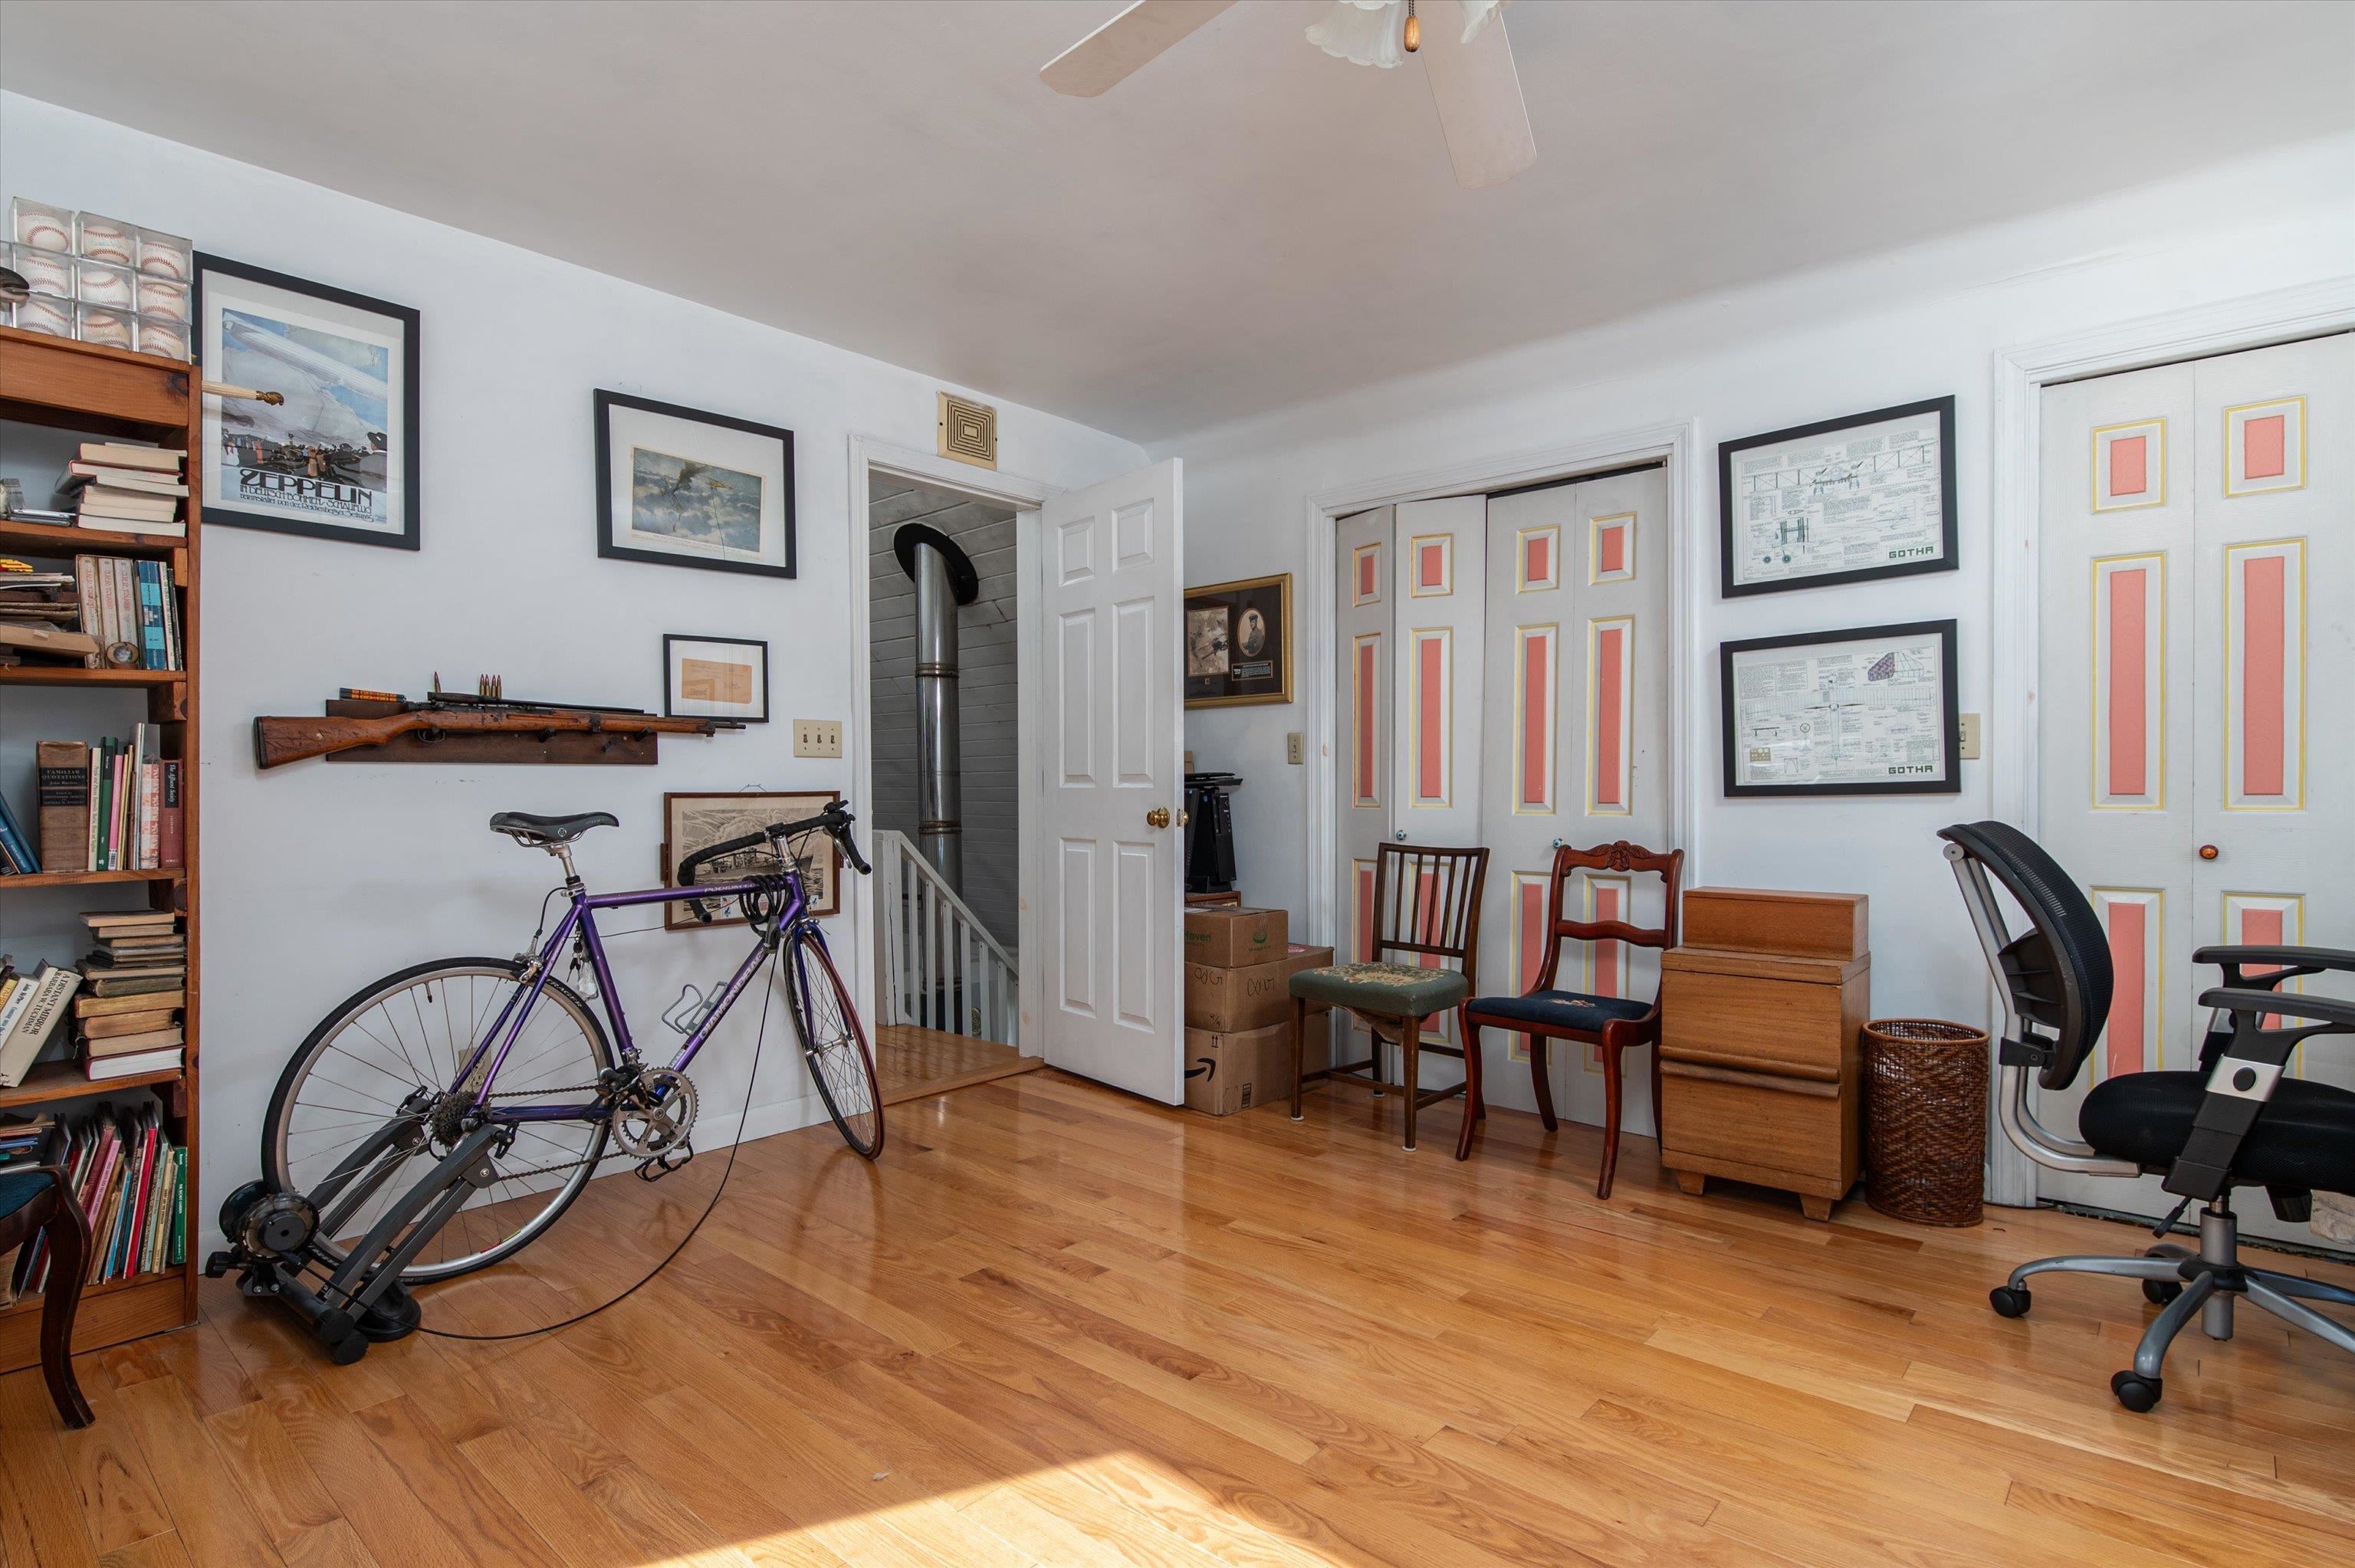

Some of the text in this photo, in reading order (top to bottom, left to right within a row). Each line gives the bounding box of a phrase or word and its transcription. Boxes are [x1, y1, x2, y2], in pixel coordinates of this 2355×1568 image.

[239, 468, 372, 507] ZEPPELIN
[1888, 546, 1933, 559] GOTHA
[1888, 765, 1933, 774] GOTHA
[42, 972, 61, 996] BARBARA
[47, 979, 68, 1007] DISTANT
[21, 1004, 44, 1034] TUCHMAN
[28, 1007, 52, 1035] MIRROR
